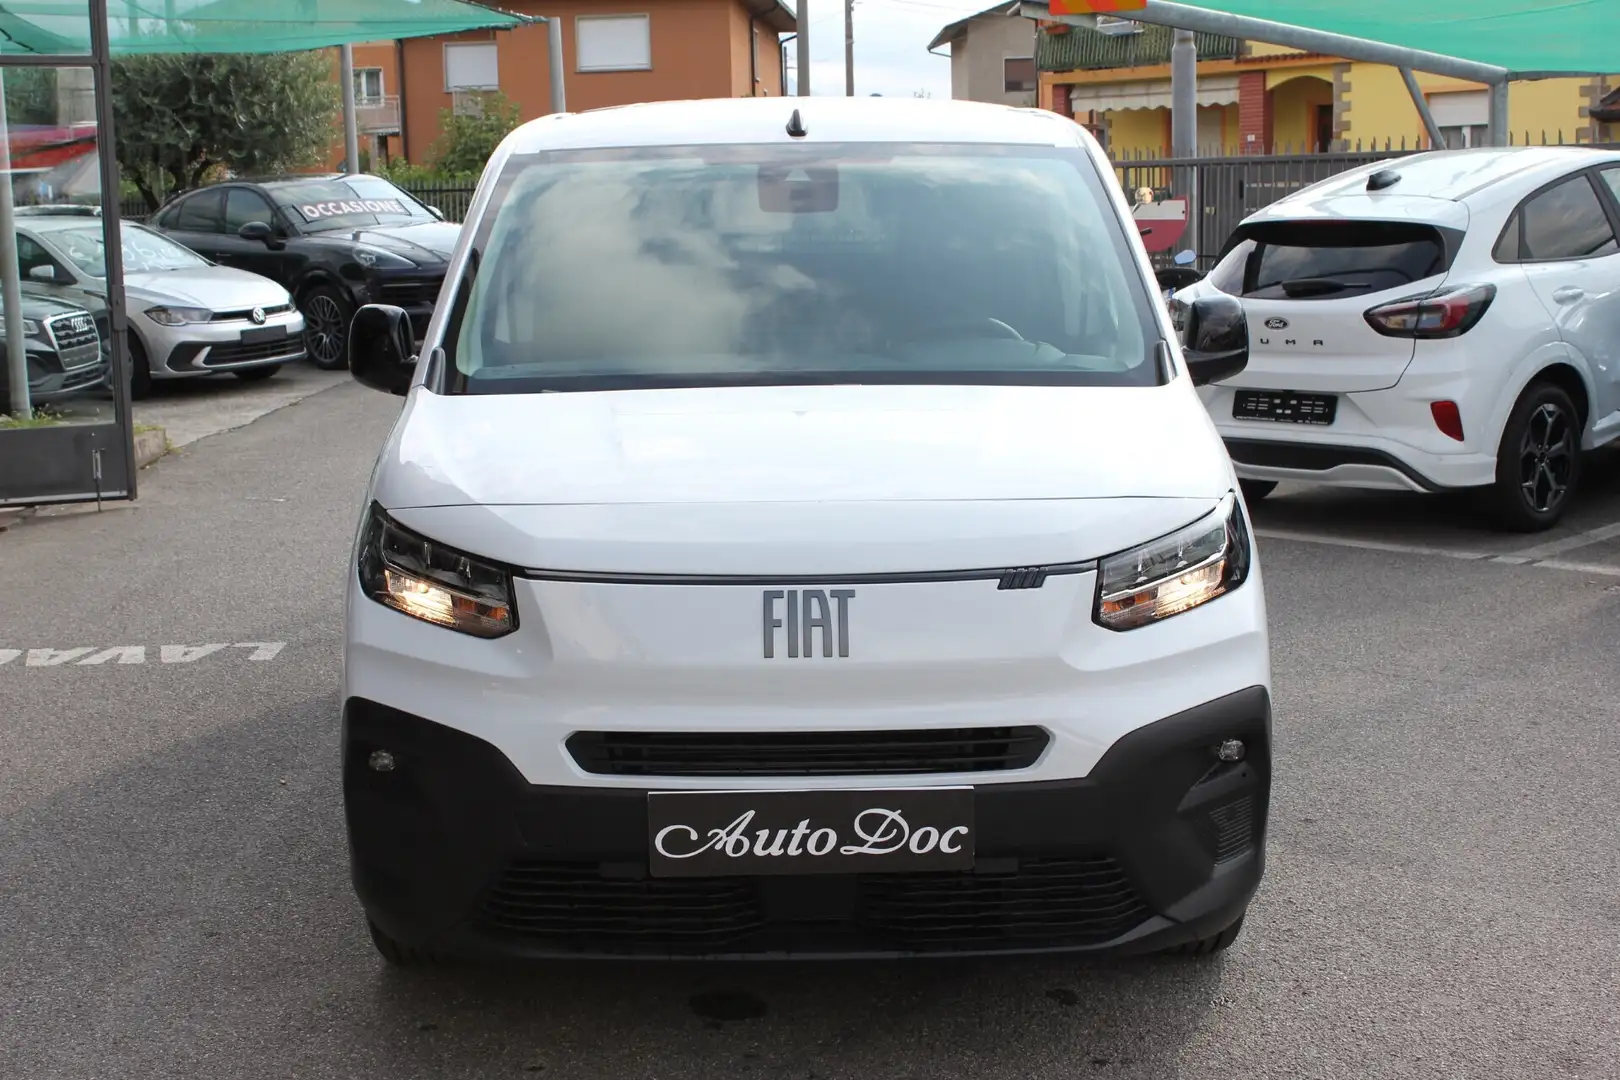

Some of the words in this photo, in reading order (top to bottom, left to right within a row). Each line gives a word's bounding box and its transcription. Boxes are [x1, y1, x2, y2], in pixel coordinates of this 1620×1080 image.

[302, 200, 405, 218] OCCASIONE
[1260, 337, 1324, 346] UMA
[763, 590, 856, 659] FIAT
[655, 808, 838, 859] Auto
[840, 807, 969, 857] Doc
